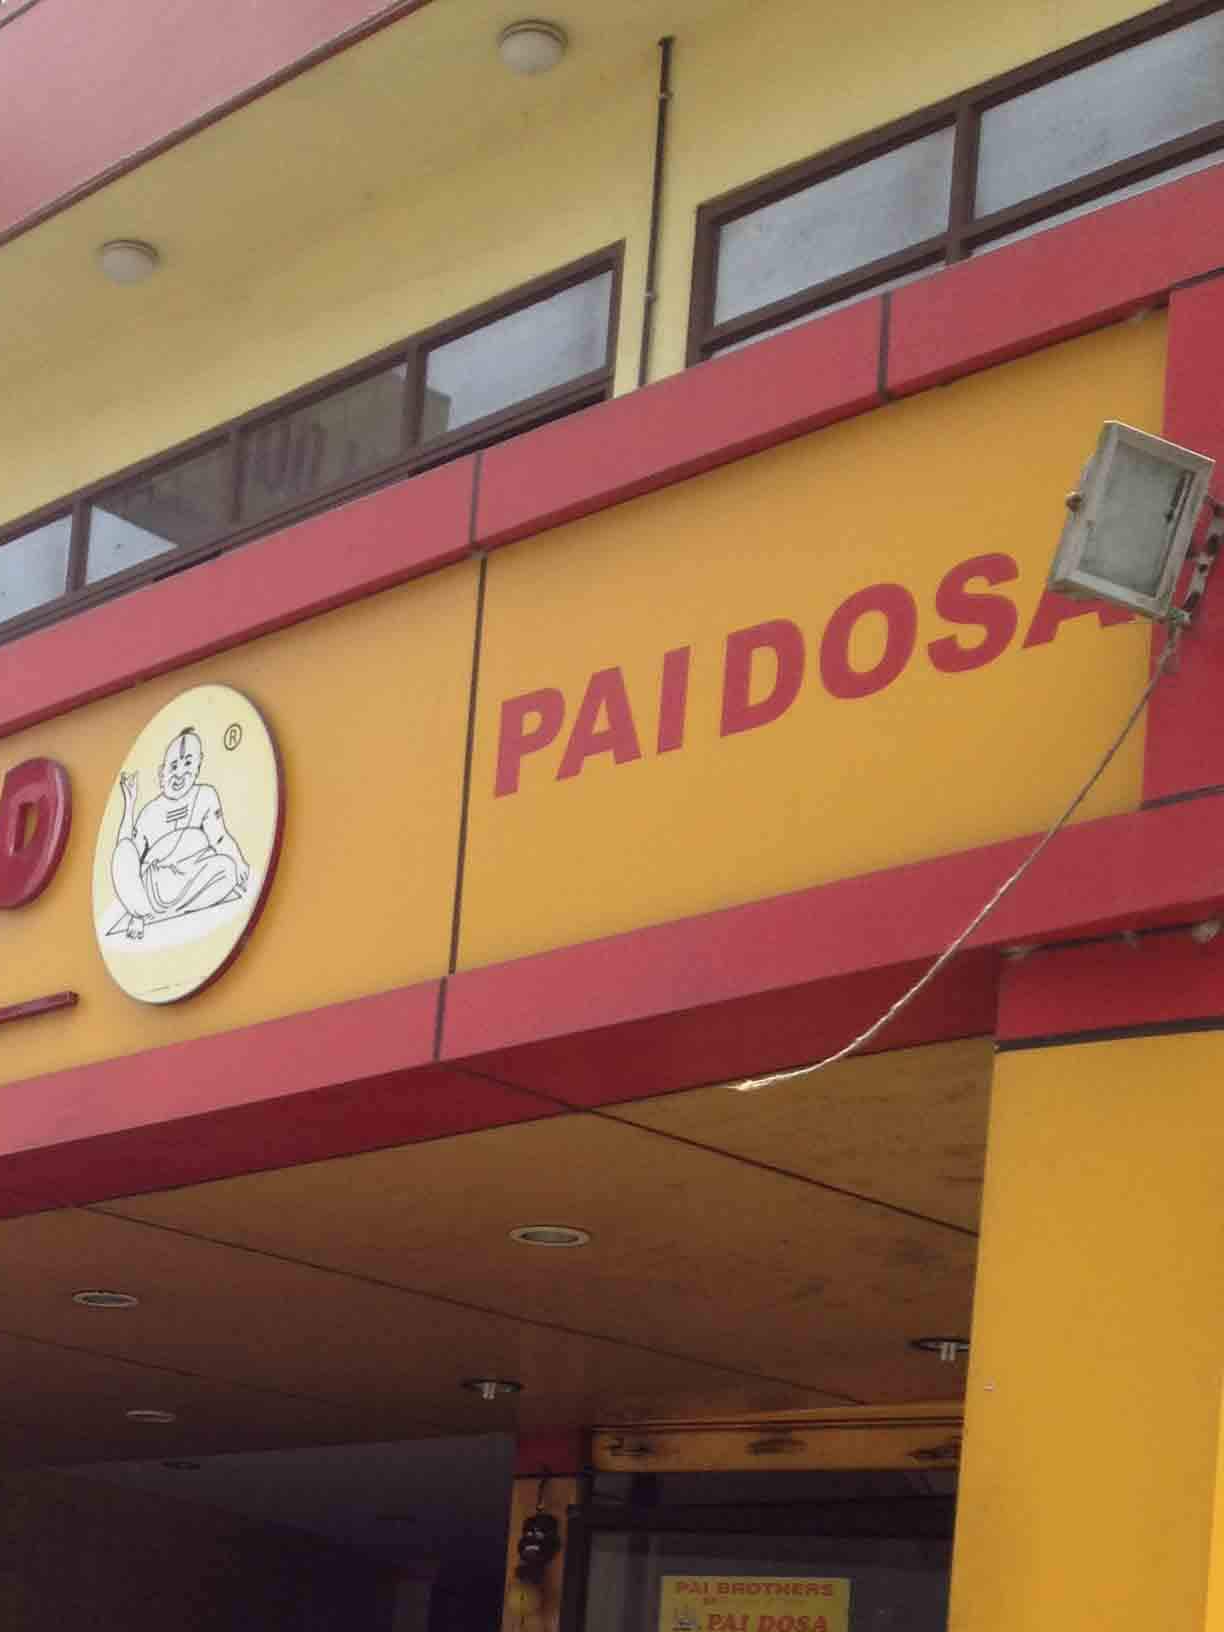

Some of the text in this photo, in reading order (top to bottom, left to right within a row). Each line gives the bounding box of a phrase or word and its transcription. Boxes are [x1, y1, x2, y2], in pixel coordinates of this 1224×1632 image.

[676, 1582, 833, 1597] PAI BROTHERS
[706, 1613, 752, 1632] PAI
